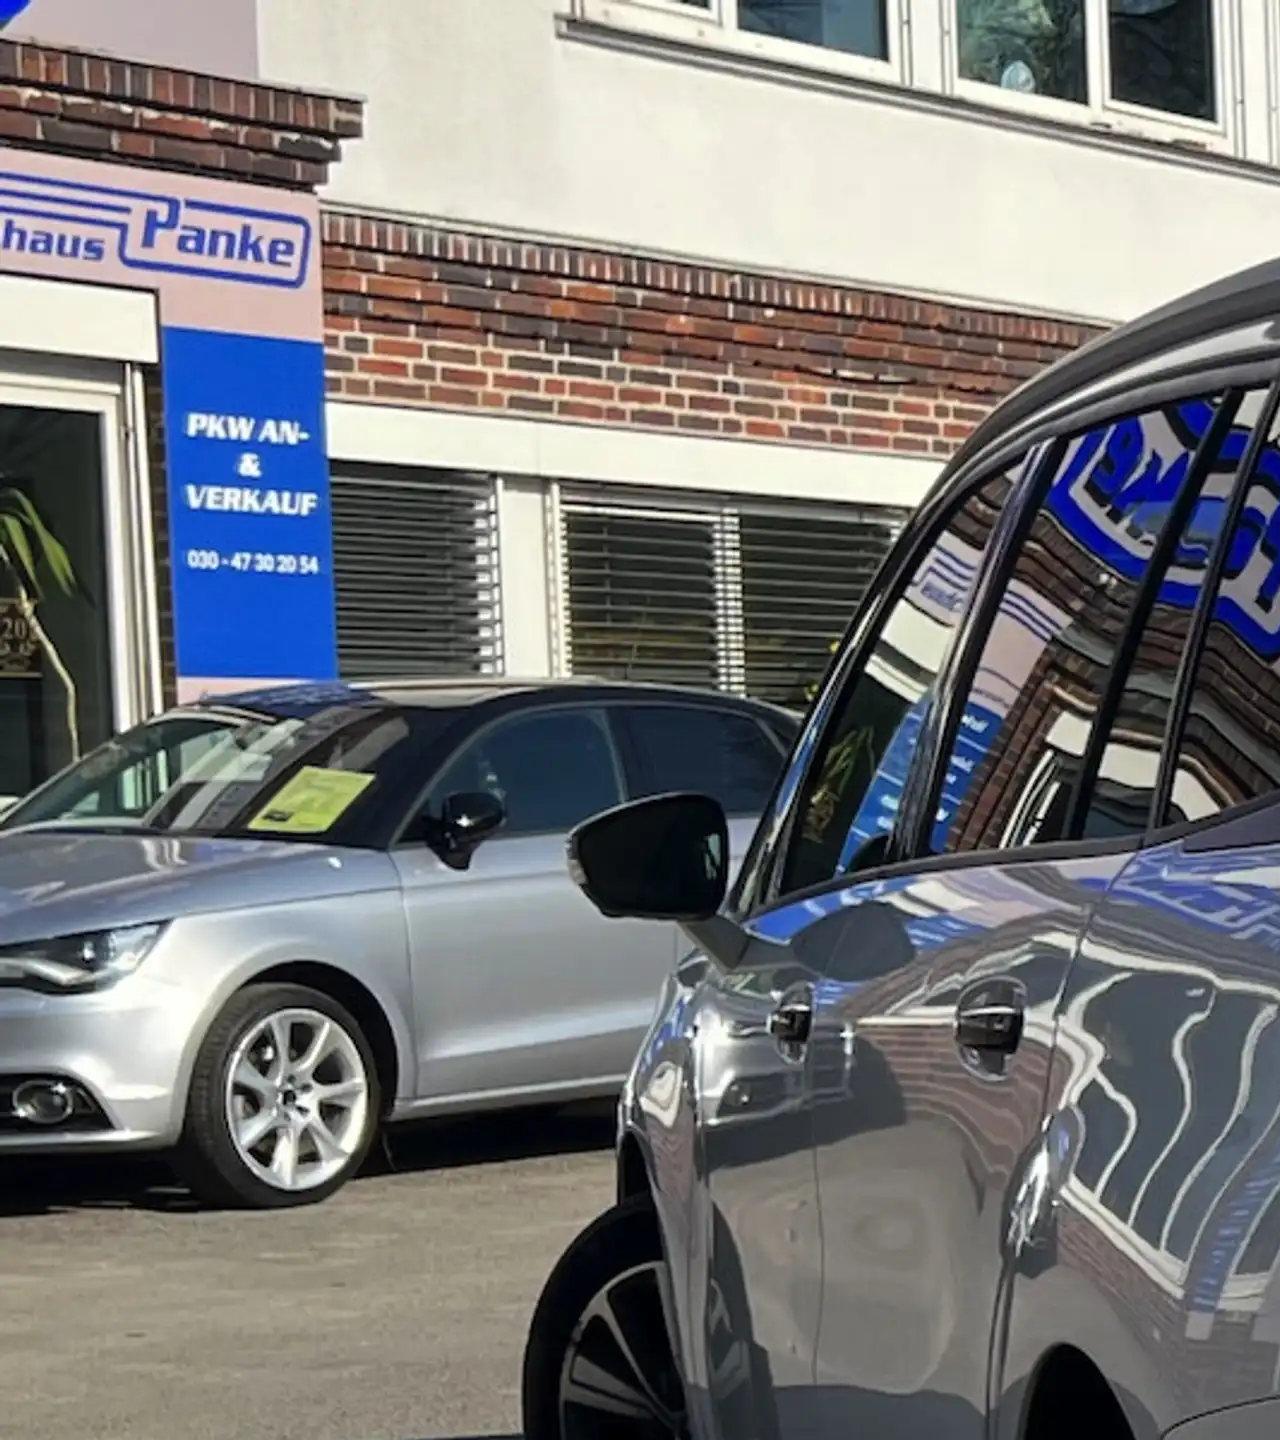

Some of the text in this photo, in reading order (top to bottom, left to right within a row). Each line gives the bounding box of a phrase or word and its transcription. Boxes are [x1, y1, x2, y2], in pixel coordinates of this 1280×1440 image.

[141, 197, 297, 267] Panke
[187, 411, 310, 445] PKW AN-
[237, 452, 262, 478] &
[185, 484, 318, 517] VERKAUF
[187, 549, 219, 571] 030
[230, 552, 252, 572] 47
[254, 553, 275, 574] 30
[276, 554, 298, 575] 20
[299, 555, 319, 576] 54
